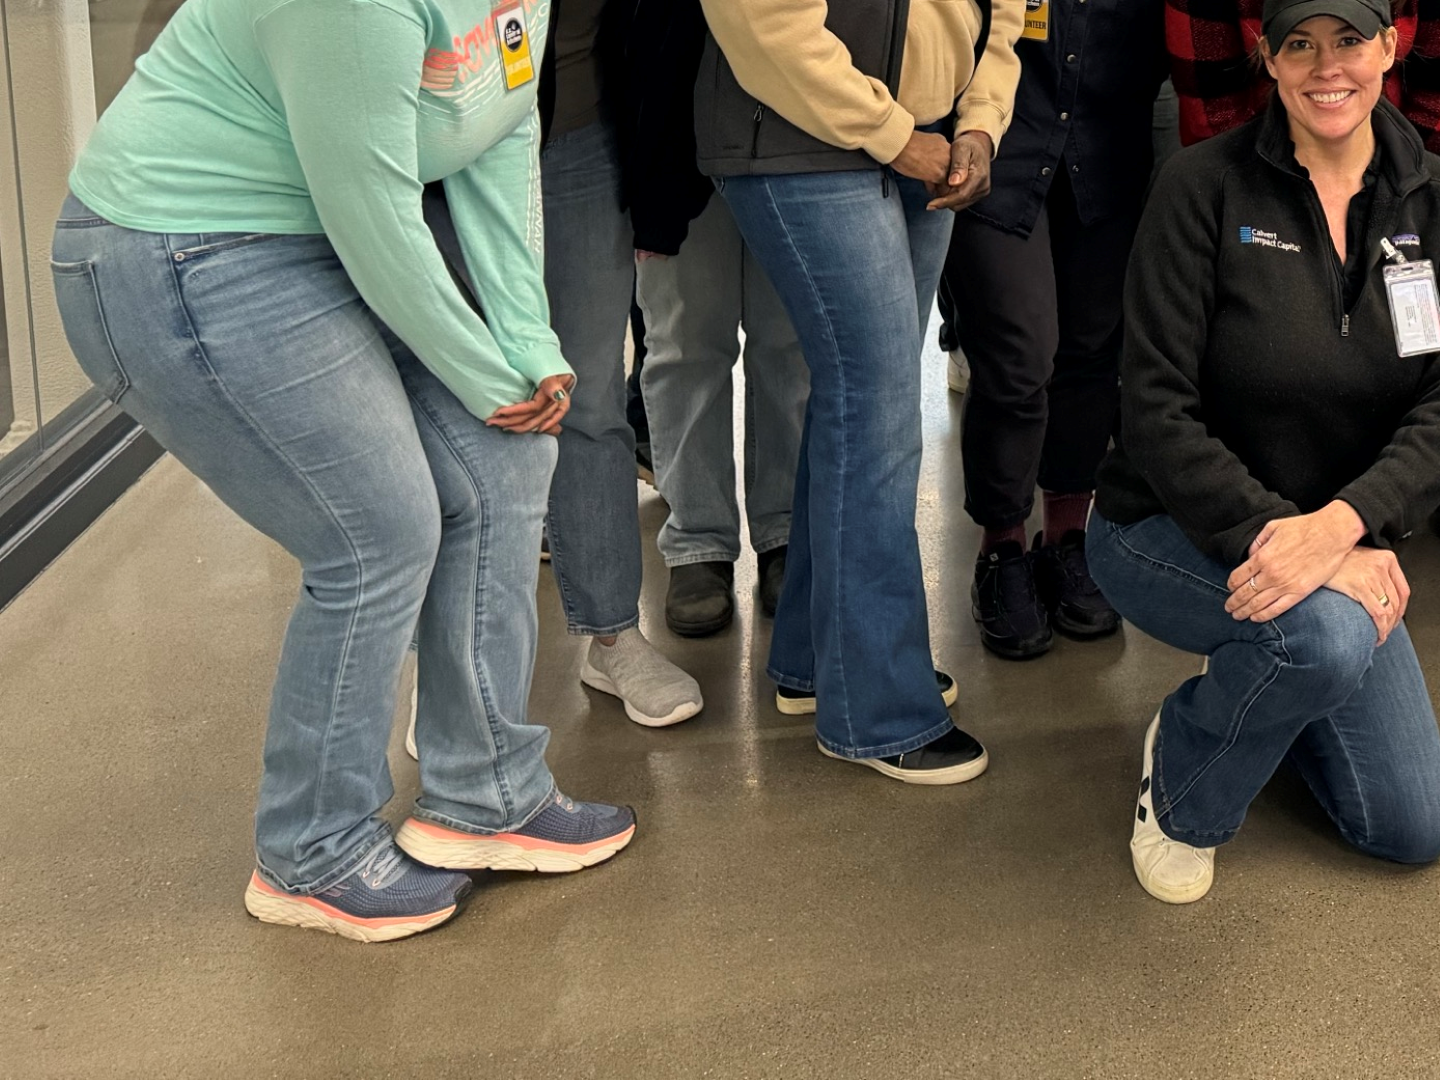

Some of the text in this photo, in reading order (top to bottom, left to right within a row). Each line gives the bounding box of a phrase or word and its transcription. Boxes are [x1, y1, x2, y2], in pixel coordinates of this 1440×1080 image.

[1025, 20, 1047, 29] UNTEER
[1251, 228, 1277, 239] Calvert
[1252, 236, 1300, 253] Impact Capital
